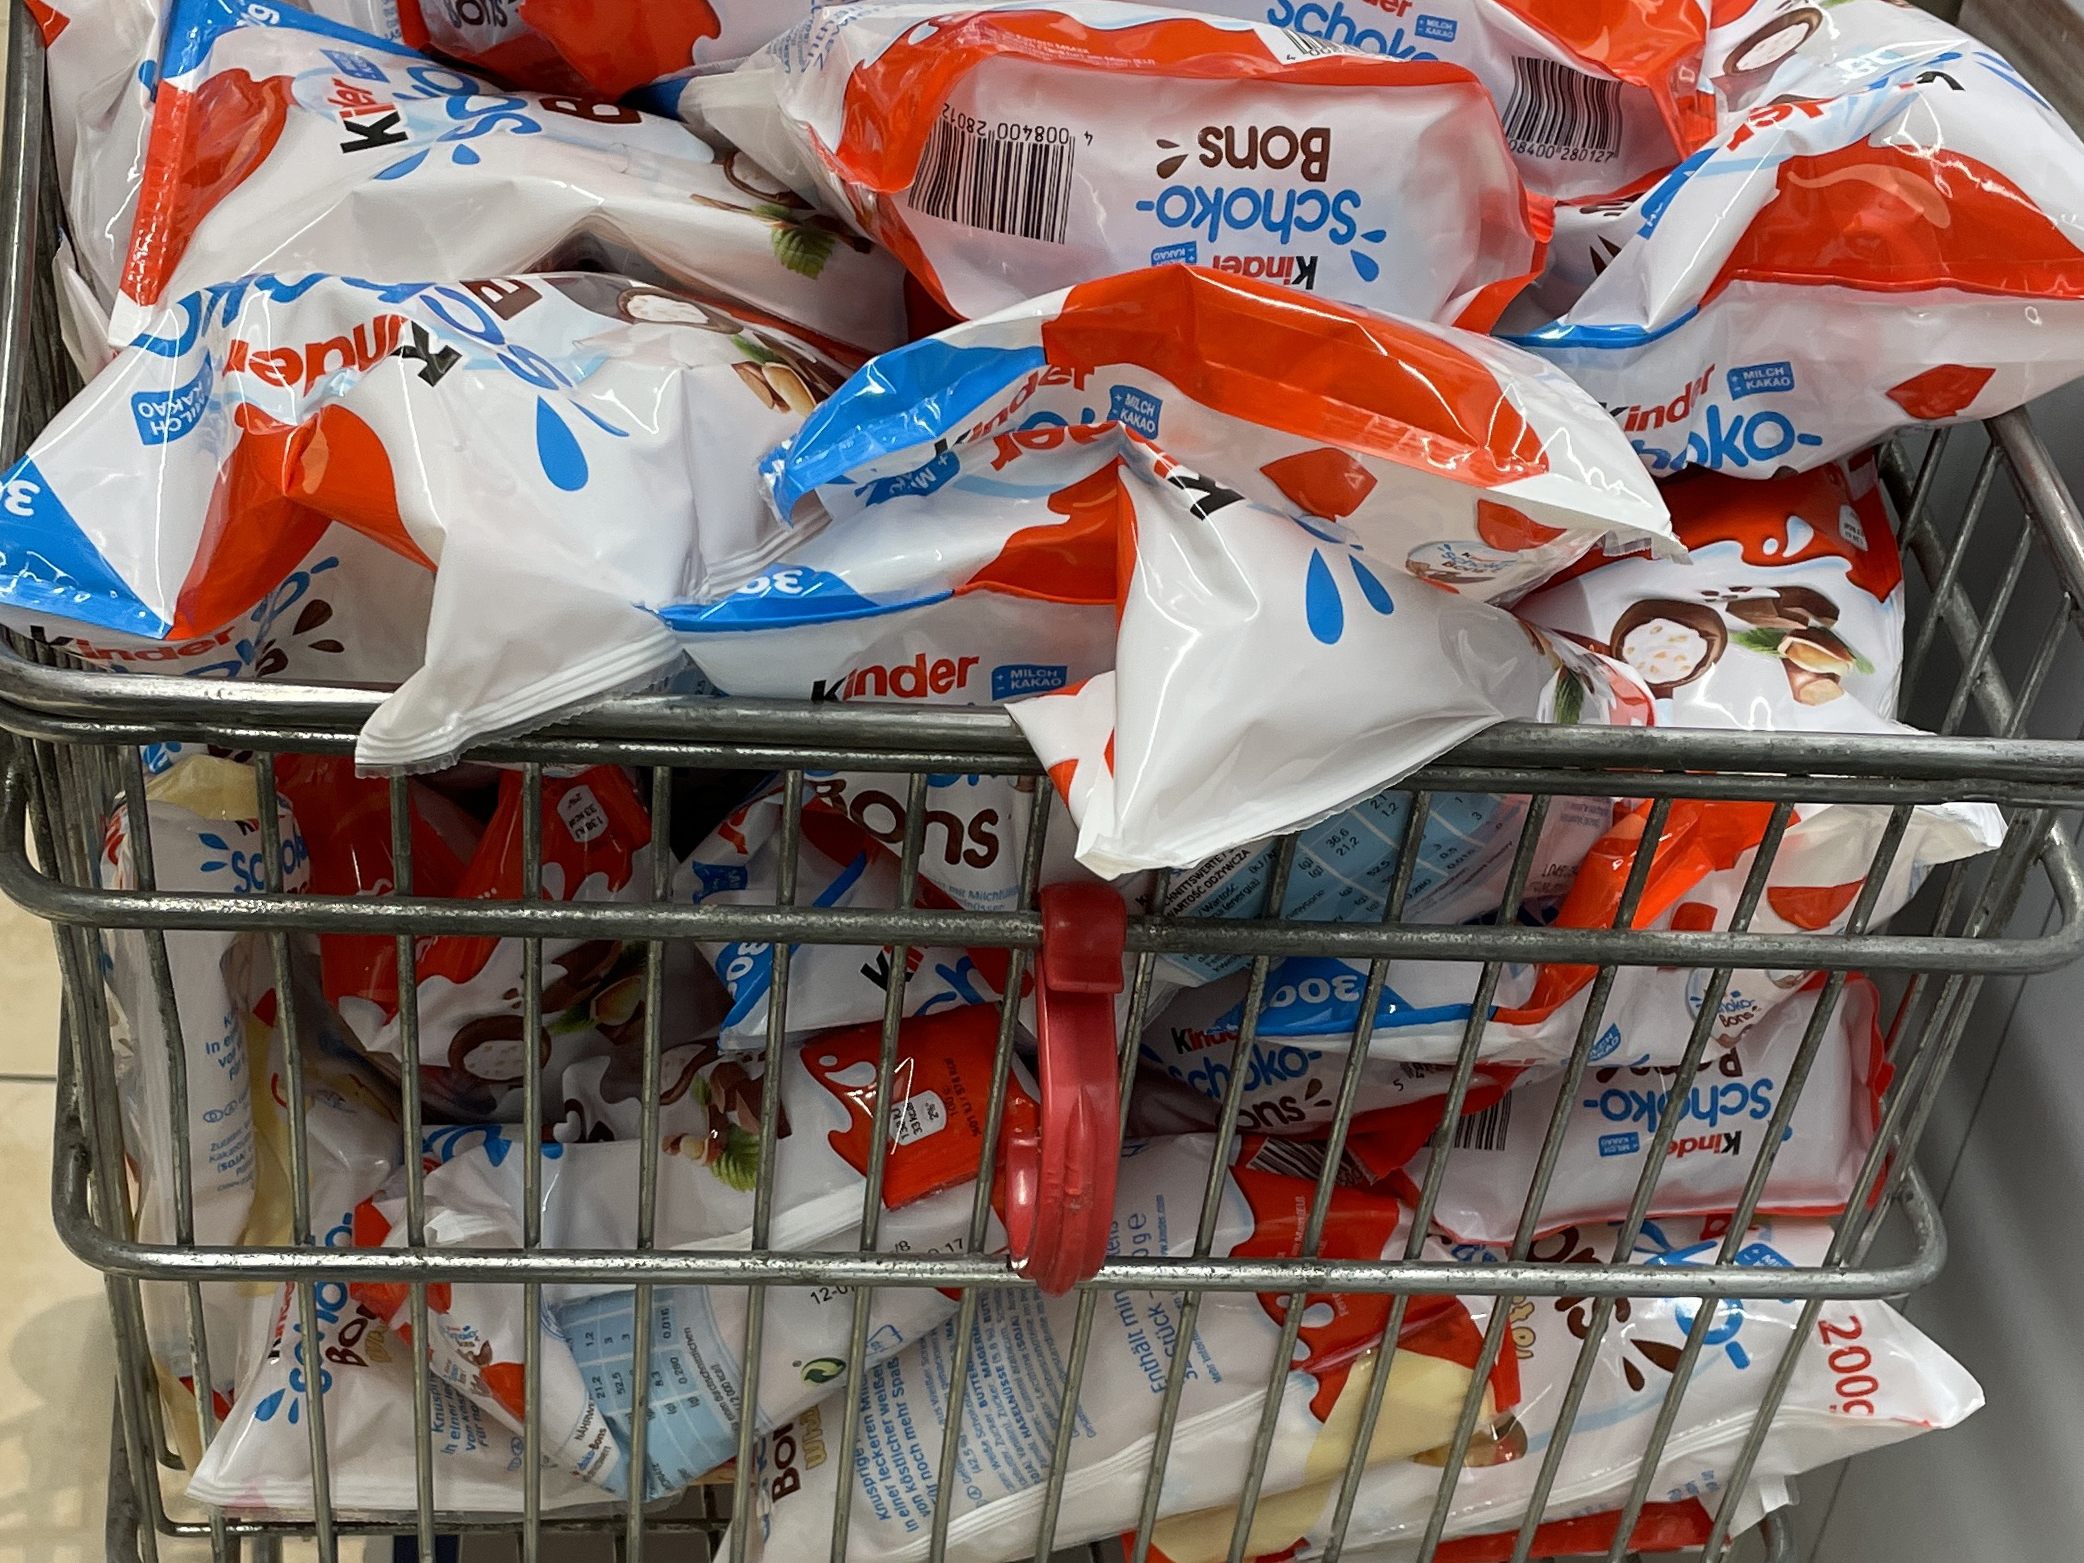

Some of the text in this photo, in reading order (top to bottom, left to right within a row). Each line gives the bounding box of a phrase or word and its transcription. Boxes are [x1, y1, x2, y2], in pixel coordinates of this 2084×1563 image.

[942, 103, 1093, 147] 4 008400 28012
[1198, 126, 1332, 182] Bons
[1509, 139, 1614, 163] 08400 280127
[1135, 184, 1362, 245] Schoko-
[1743, 367, 1785, 381] MILCH
[1746, 377, 1791, 390] KAKAO
[1120, 406, 1157, 434] KAKAO
[1124, 393, 1156, 417] MILCH
[811, 653, 980, 704] Kinder
[1009, 669, 1058, 679] MILCH
[1011, 677, 1063, 691] KAKAO
[1335, 836, 1360, 858] 21,2
[1664, 1130, 1742, 1159] Kinde
[1126, 1327, 1169, 1395] Enthält
[591, 1374, 607, 1400] 21,2
[886, 1356, 906, 1399] Spaß
[994, 1361, 1034, 1440] HASELNÜSSE
[895, 1402, 918, 1441] mehr
[863, 1414, 893, 1482] leckeren
[881, 1419, 919, 1494] köstlicher
[909, 1443, 933, 1481] noch
[885, 1483, 911, 1519] einer
[911, 1492, 932, 1518] von
[904, 1518, 921, 1533] In
